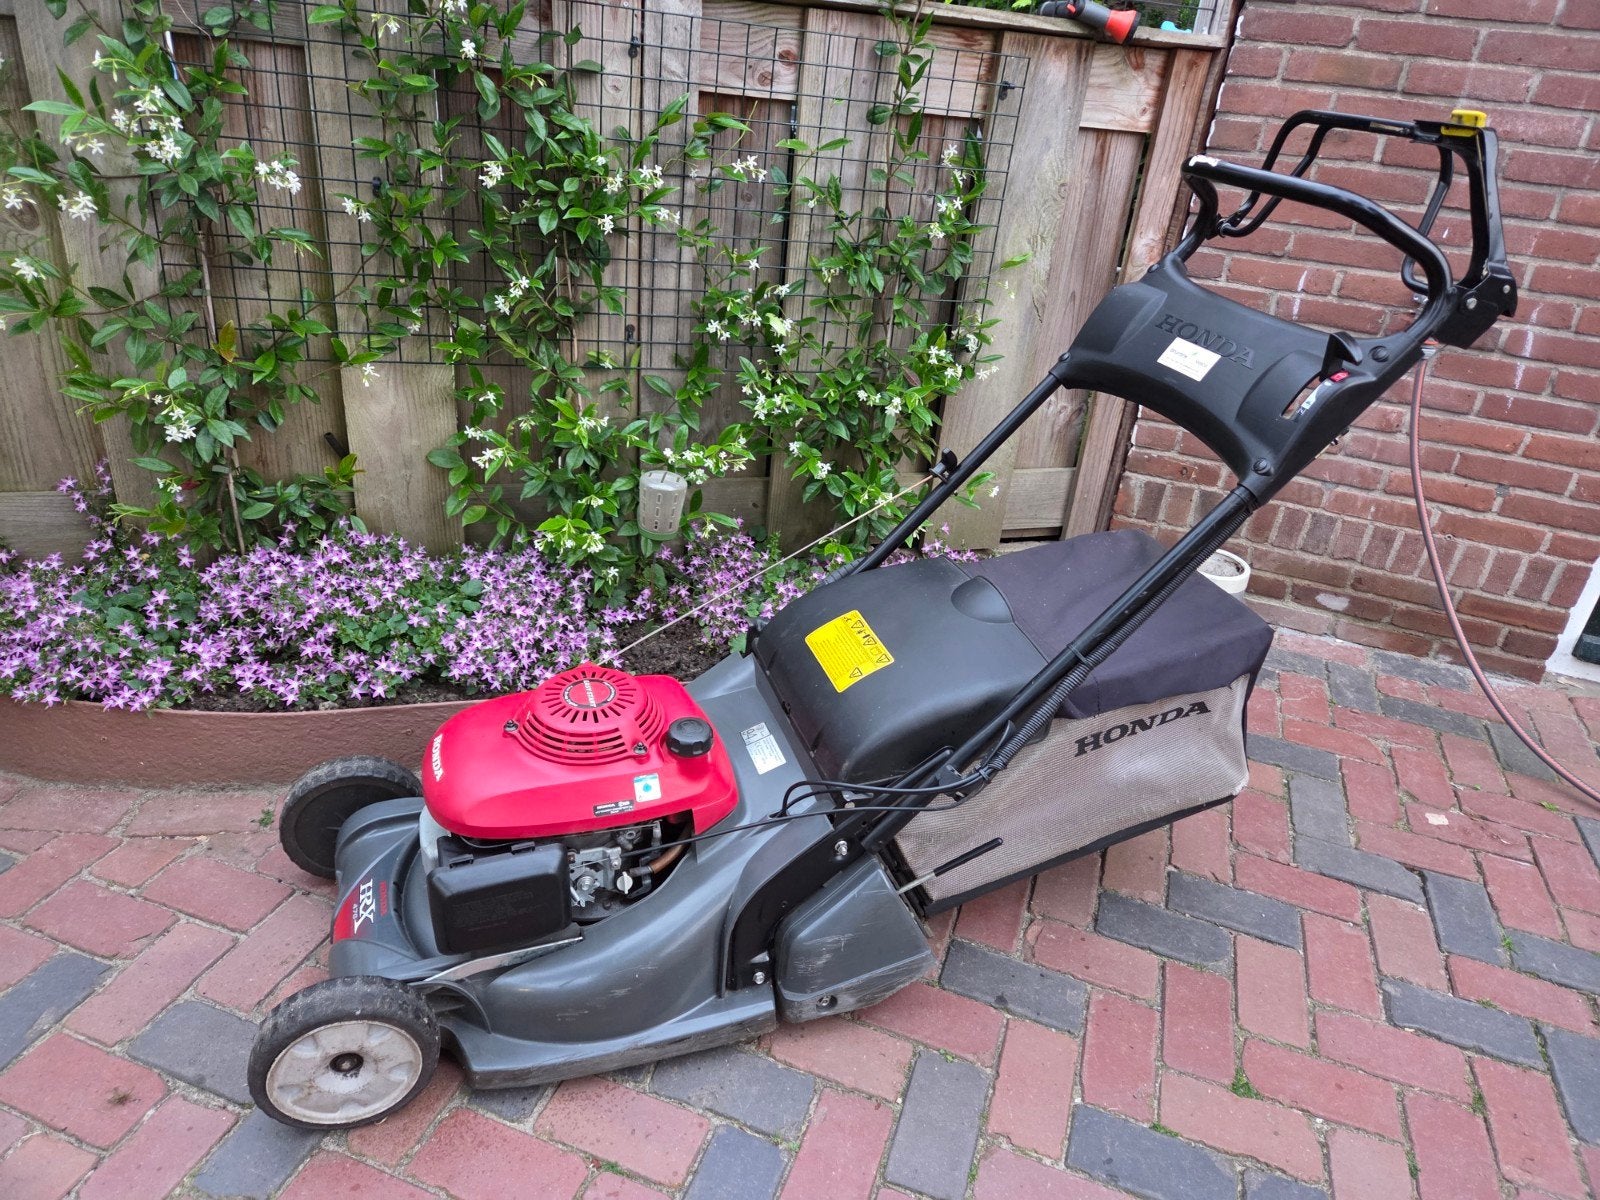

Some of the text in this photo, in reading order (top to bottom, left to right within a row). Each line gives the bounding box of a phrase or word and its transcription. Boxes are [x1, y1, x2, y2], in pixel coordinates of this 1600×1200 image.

[1154, 313, 1255, 370] HONDA
[583, 679, 592, 691] EASY
[1074, 701, 1212, 757] HONDA
[432, 733, 444, 782] HONDA
[354, 878, 376, 934] HRX
